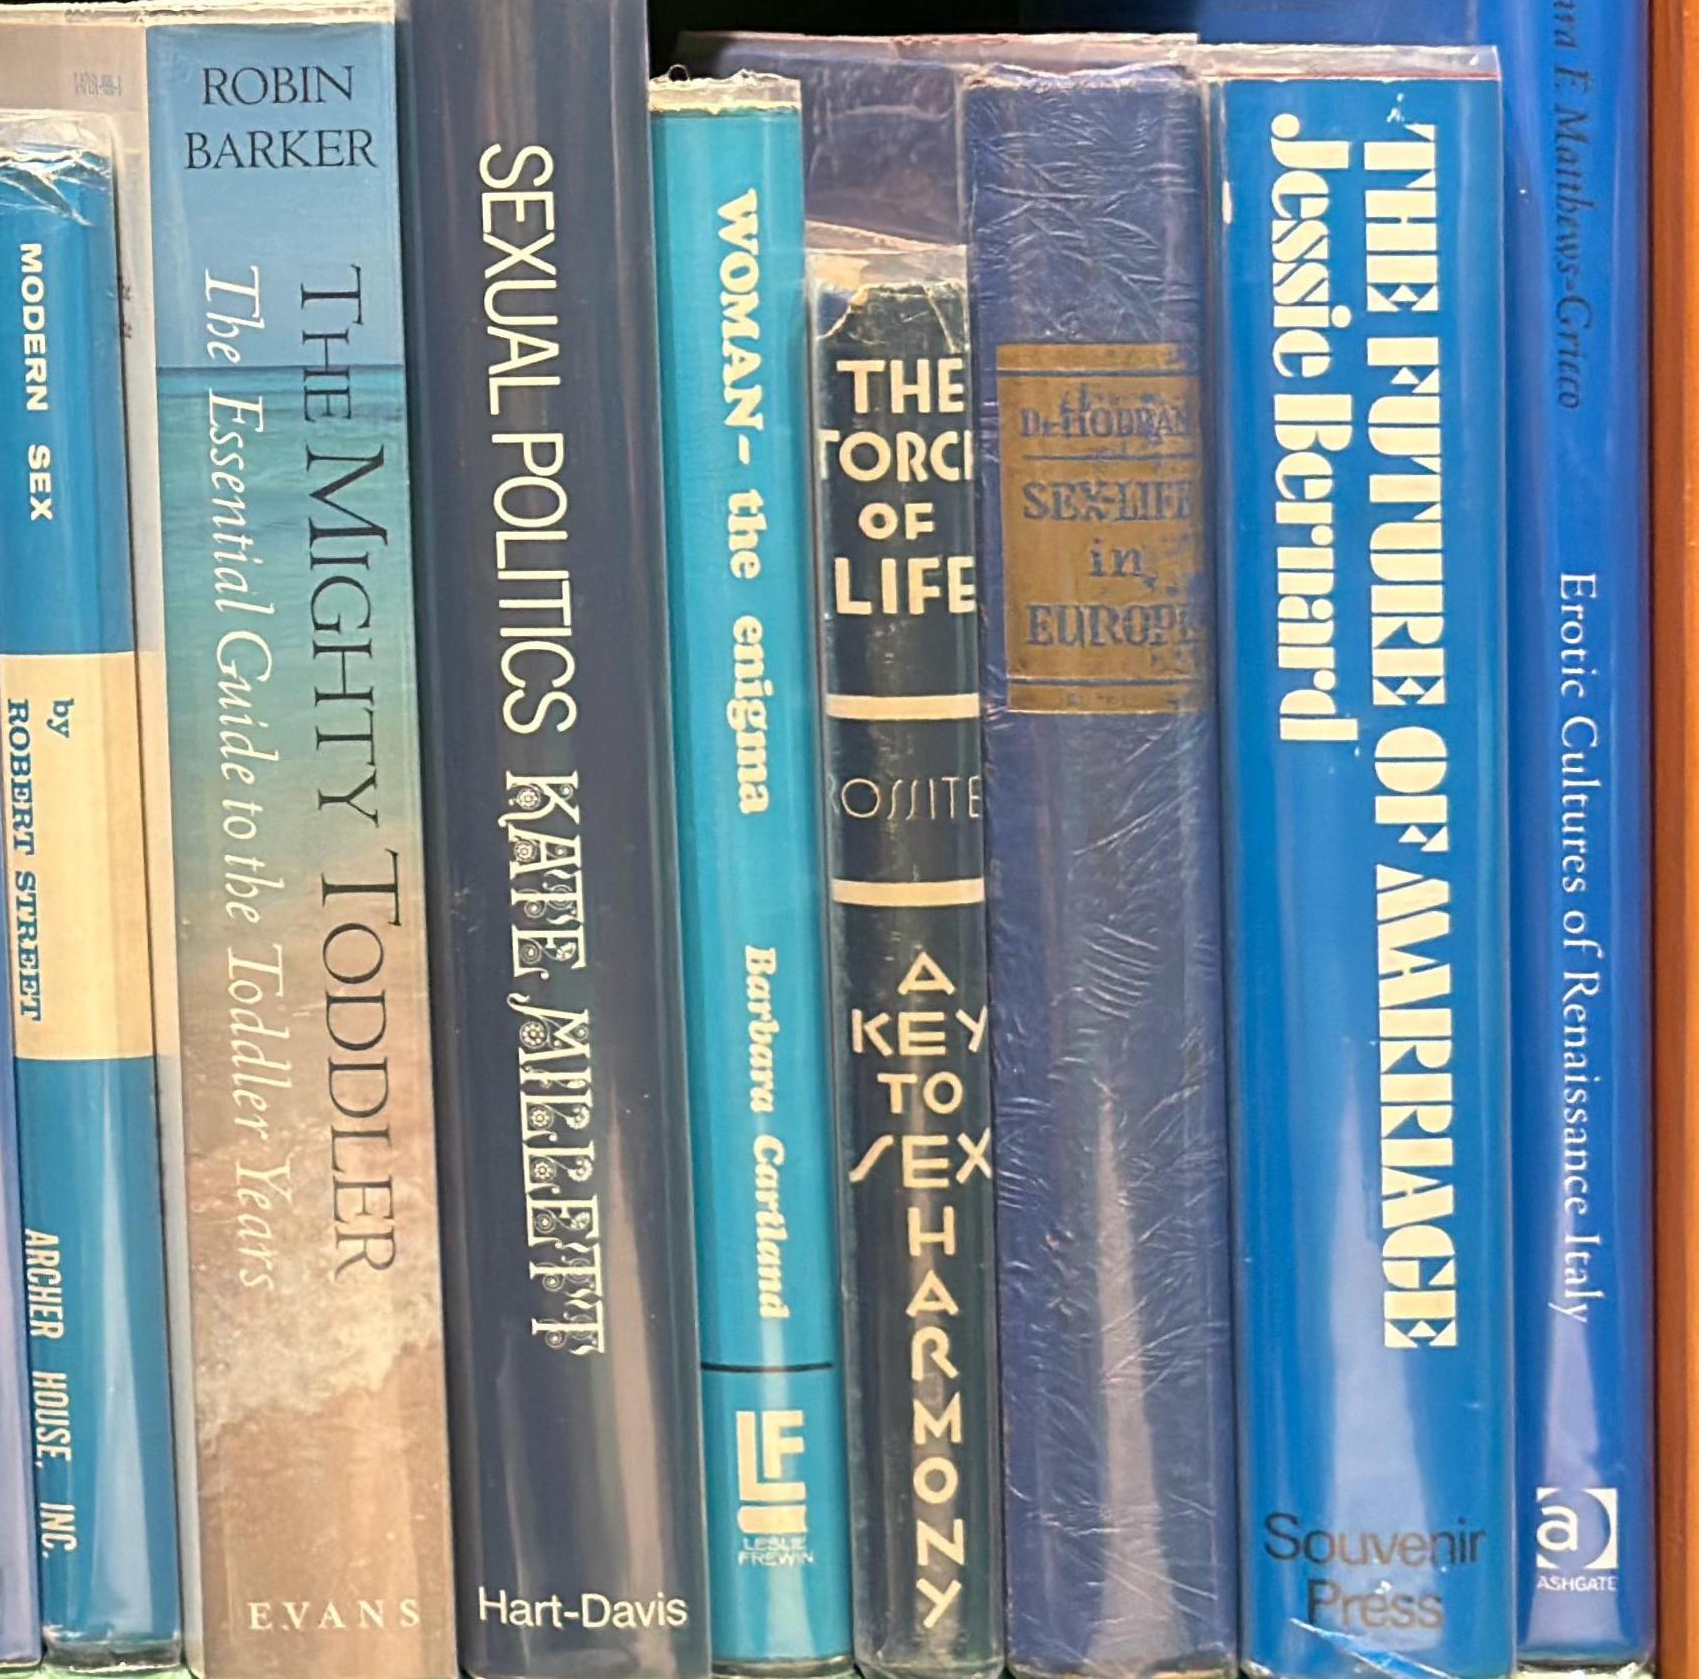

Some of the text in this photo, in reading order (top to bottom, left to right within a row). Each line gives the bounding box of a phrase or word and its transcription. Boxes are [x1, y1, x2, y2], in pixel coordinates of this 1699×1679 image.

[202, 65, 353, 106] ROBIN
[185, 129, 378, 170] BARKER
[20, 243, 53, 522] MODERN SEX
[836, 358, 964, 414] THE
[1271, 113, 1358, 742] Jessie Bernard
[728, 488, 766, 579] the
[835, 556, 976, 615] LIFE
[479, 144, 605, 1356] SEXUAL POLITICS KATE MILLETT
[728, 615, 775, 815] enigma
[1363, 122, 1456, 1348] THE FUTURE OF MARRIAGE
[299, 263, 402, 1282] THE MIGHTY TODDLER
[6, 699, 42, 1023] ROBERT STREET
[1548, 571, 1604, 1323] Erotic Cultures of Renaissance Italy
[743, 945, 790, 1319] Barbara Cartland
[24, 1228, 76, 1559] ARCHER HOUSE, INC.
[738, 1551, 813, 1566] FREWIN
[743, 1536, 806, 1550] LESLIE
[1264, 1514, 1486, 1567] Souvenir
[247, 1598, 420, 1630] EVANS
[477, 1585, 688, 1631] Hart-Davis
[1307, 1580, 1443, 1630] Press
[1537, 1575, 1617, 1592] ASHGATE
